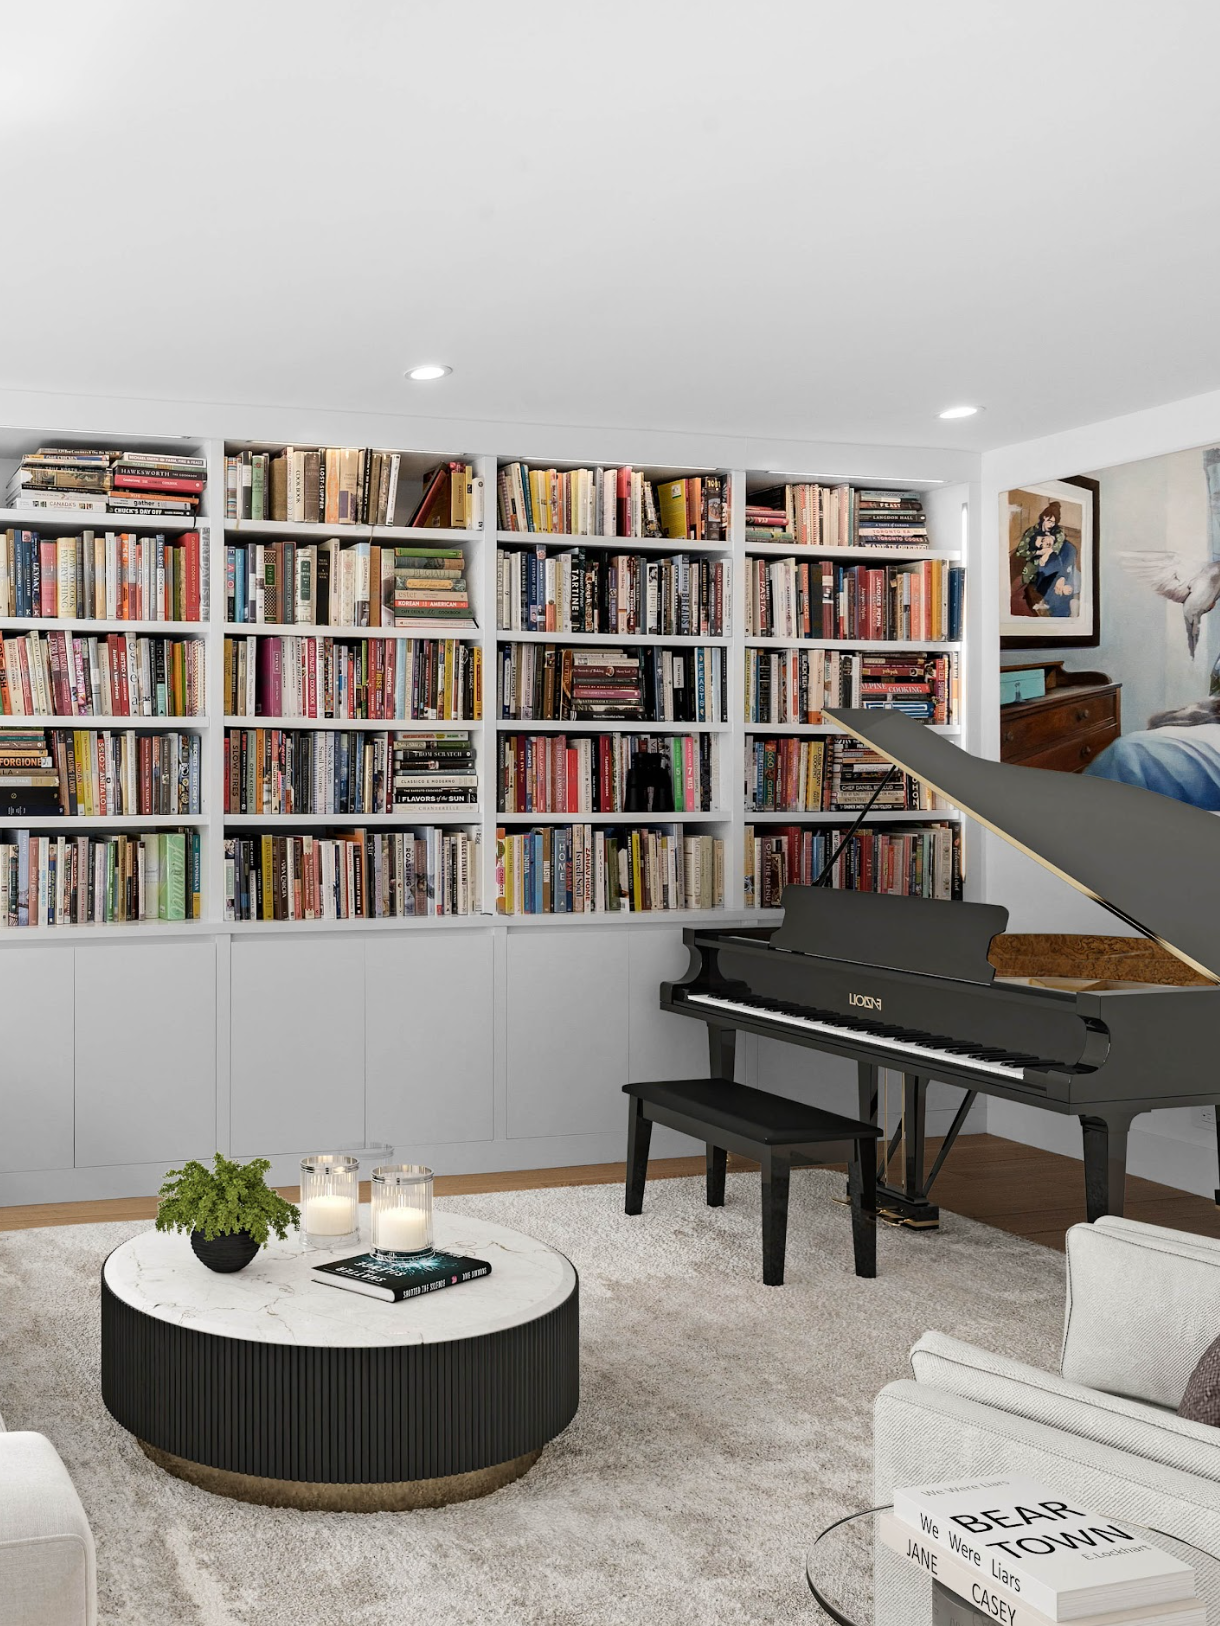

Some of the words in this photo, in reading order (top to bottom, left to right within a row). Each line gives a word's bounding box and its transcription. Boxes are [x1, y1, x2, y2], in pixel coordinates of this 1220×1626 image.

[121, 469, 170, 477] HAWKSWORTH
[69, 573, 75, 583] TO
[571, 569, 579, 611] TARTINE
[0, 669, 7, 689] FISH
[67, 750, 75, 773] CHASING
[767, 751, 775, 768] 660
[68, 774, 76, 794] FLAVOR
[767, 779, 775, 805] curries
[100, 794, 107, 805] LO
[367, 842, 375, 855] stir
[575, 851, 583, 877] Israeli
[575, 878, 583, 898] Soul
[945, 1484, 979, 1494] Were
[980, 1480, 1011, 1488] Liars
[949, 1501, 1087, 1534] BEAR
[985, 1524, 1135, 1559] TOWN
[920, 1512, 939, 1539] We
[948, 1530, 981, 1567] Were
[992, 1558, 1021, 1593] Liars
[1081, 1544, 1152, 1561] E.Lockhart
[906, 1538, 938, 1576] JANE
[972, 1583, 1017, 1626] CASEY
